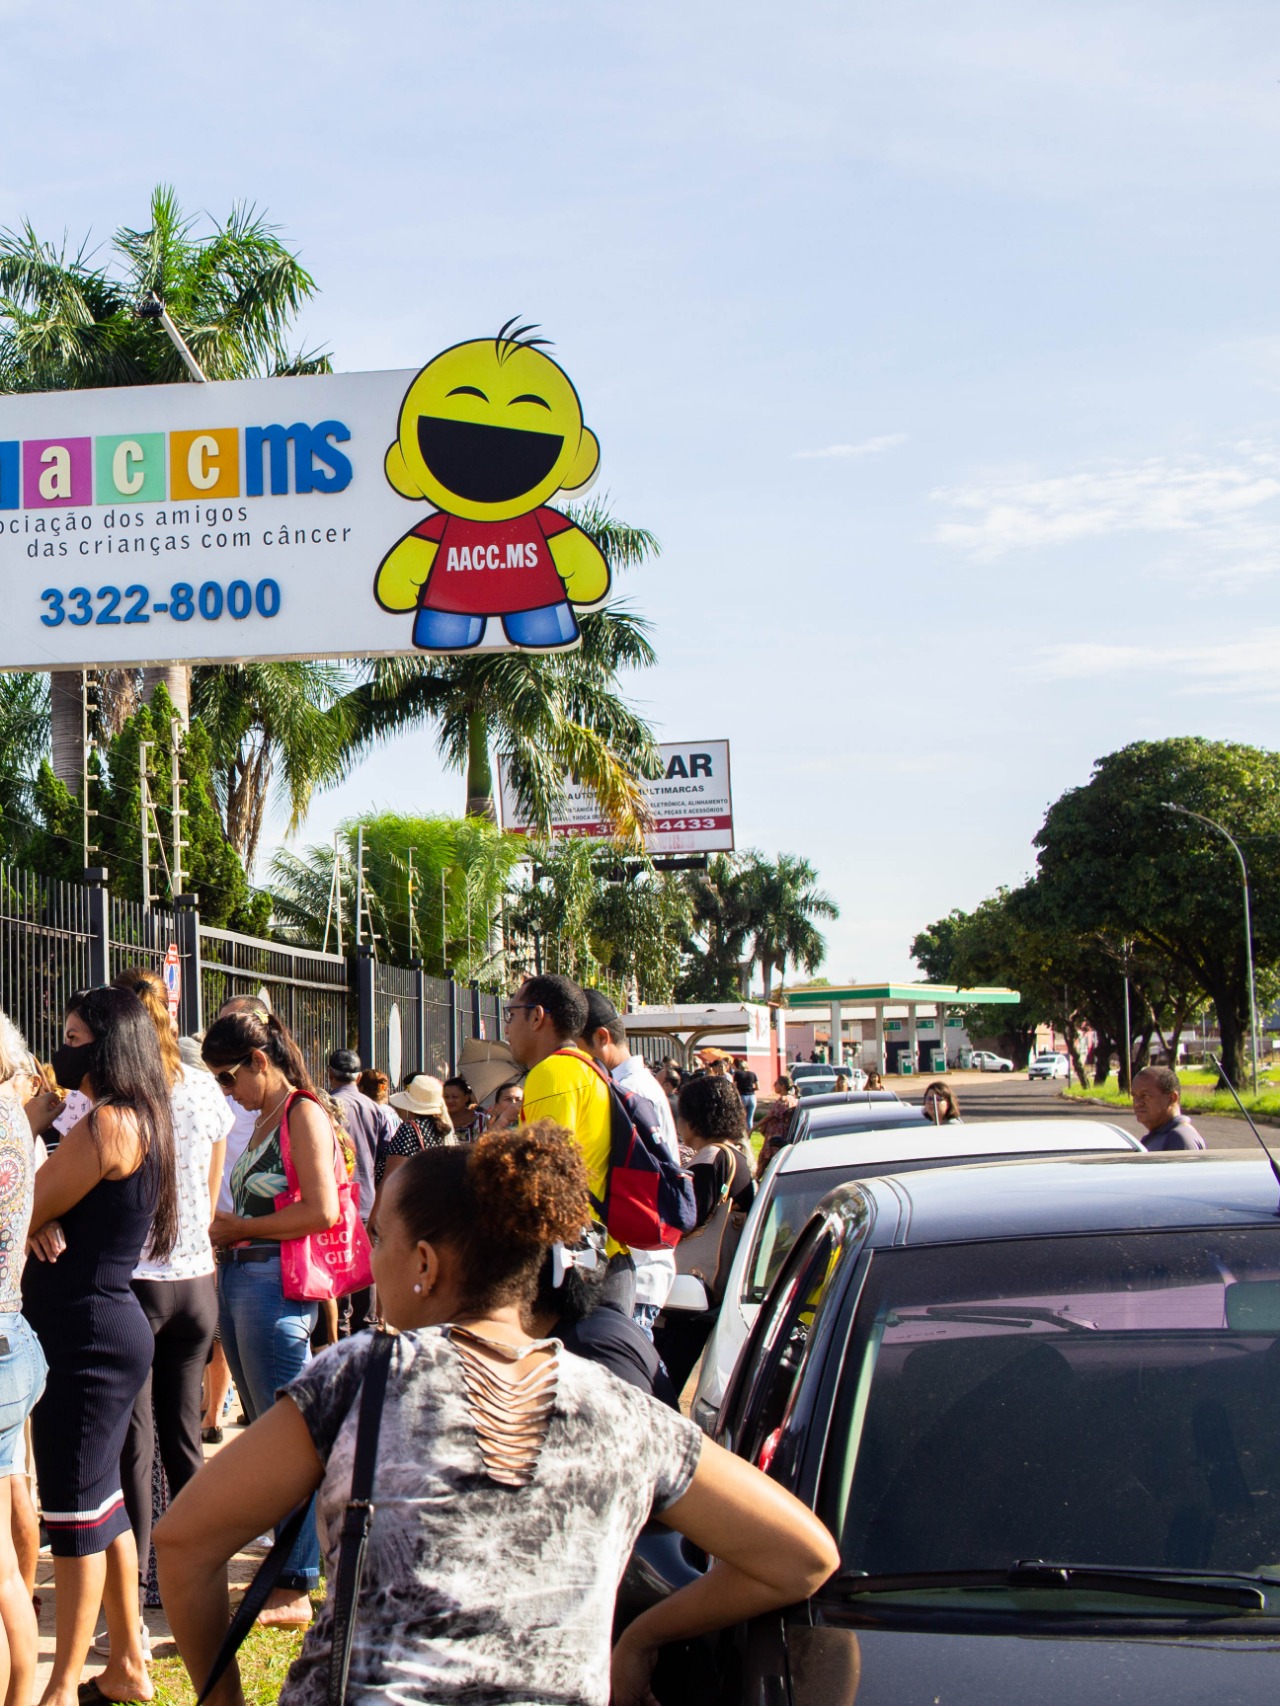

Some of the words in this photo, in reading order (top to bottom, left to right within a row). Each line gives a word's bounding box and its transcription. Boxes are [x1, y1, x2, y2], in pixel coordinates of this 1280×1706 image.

[103, 509, 145, 529] dos
[156, 505, 248, 527] amigos
[27, 538, 68, 558] das
[79, 534, 191, 556] crianças
[201, 531, 251, 549] com
[263, 525, 352, 546] câncer
[446, 542, 539, 572] AACC.MS
[39, 578, 282, 627] 3322-8000
[688, 798, 728, 806] ALINHAMENTO
